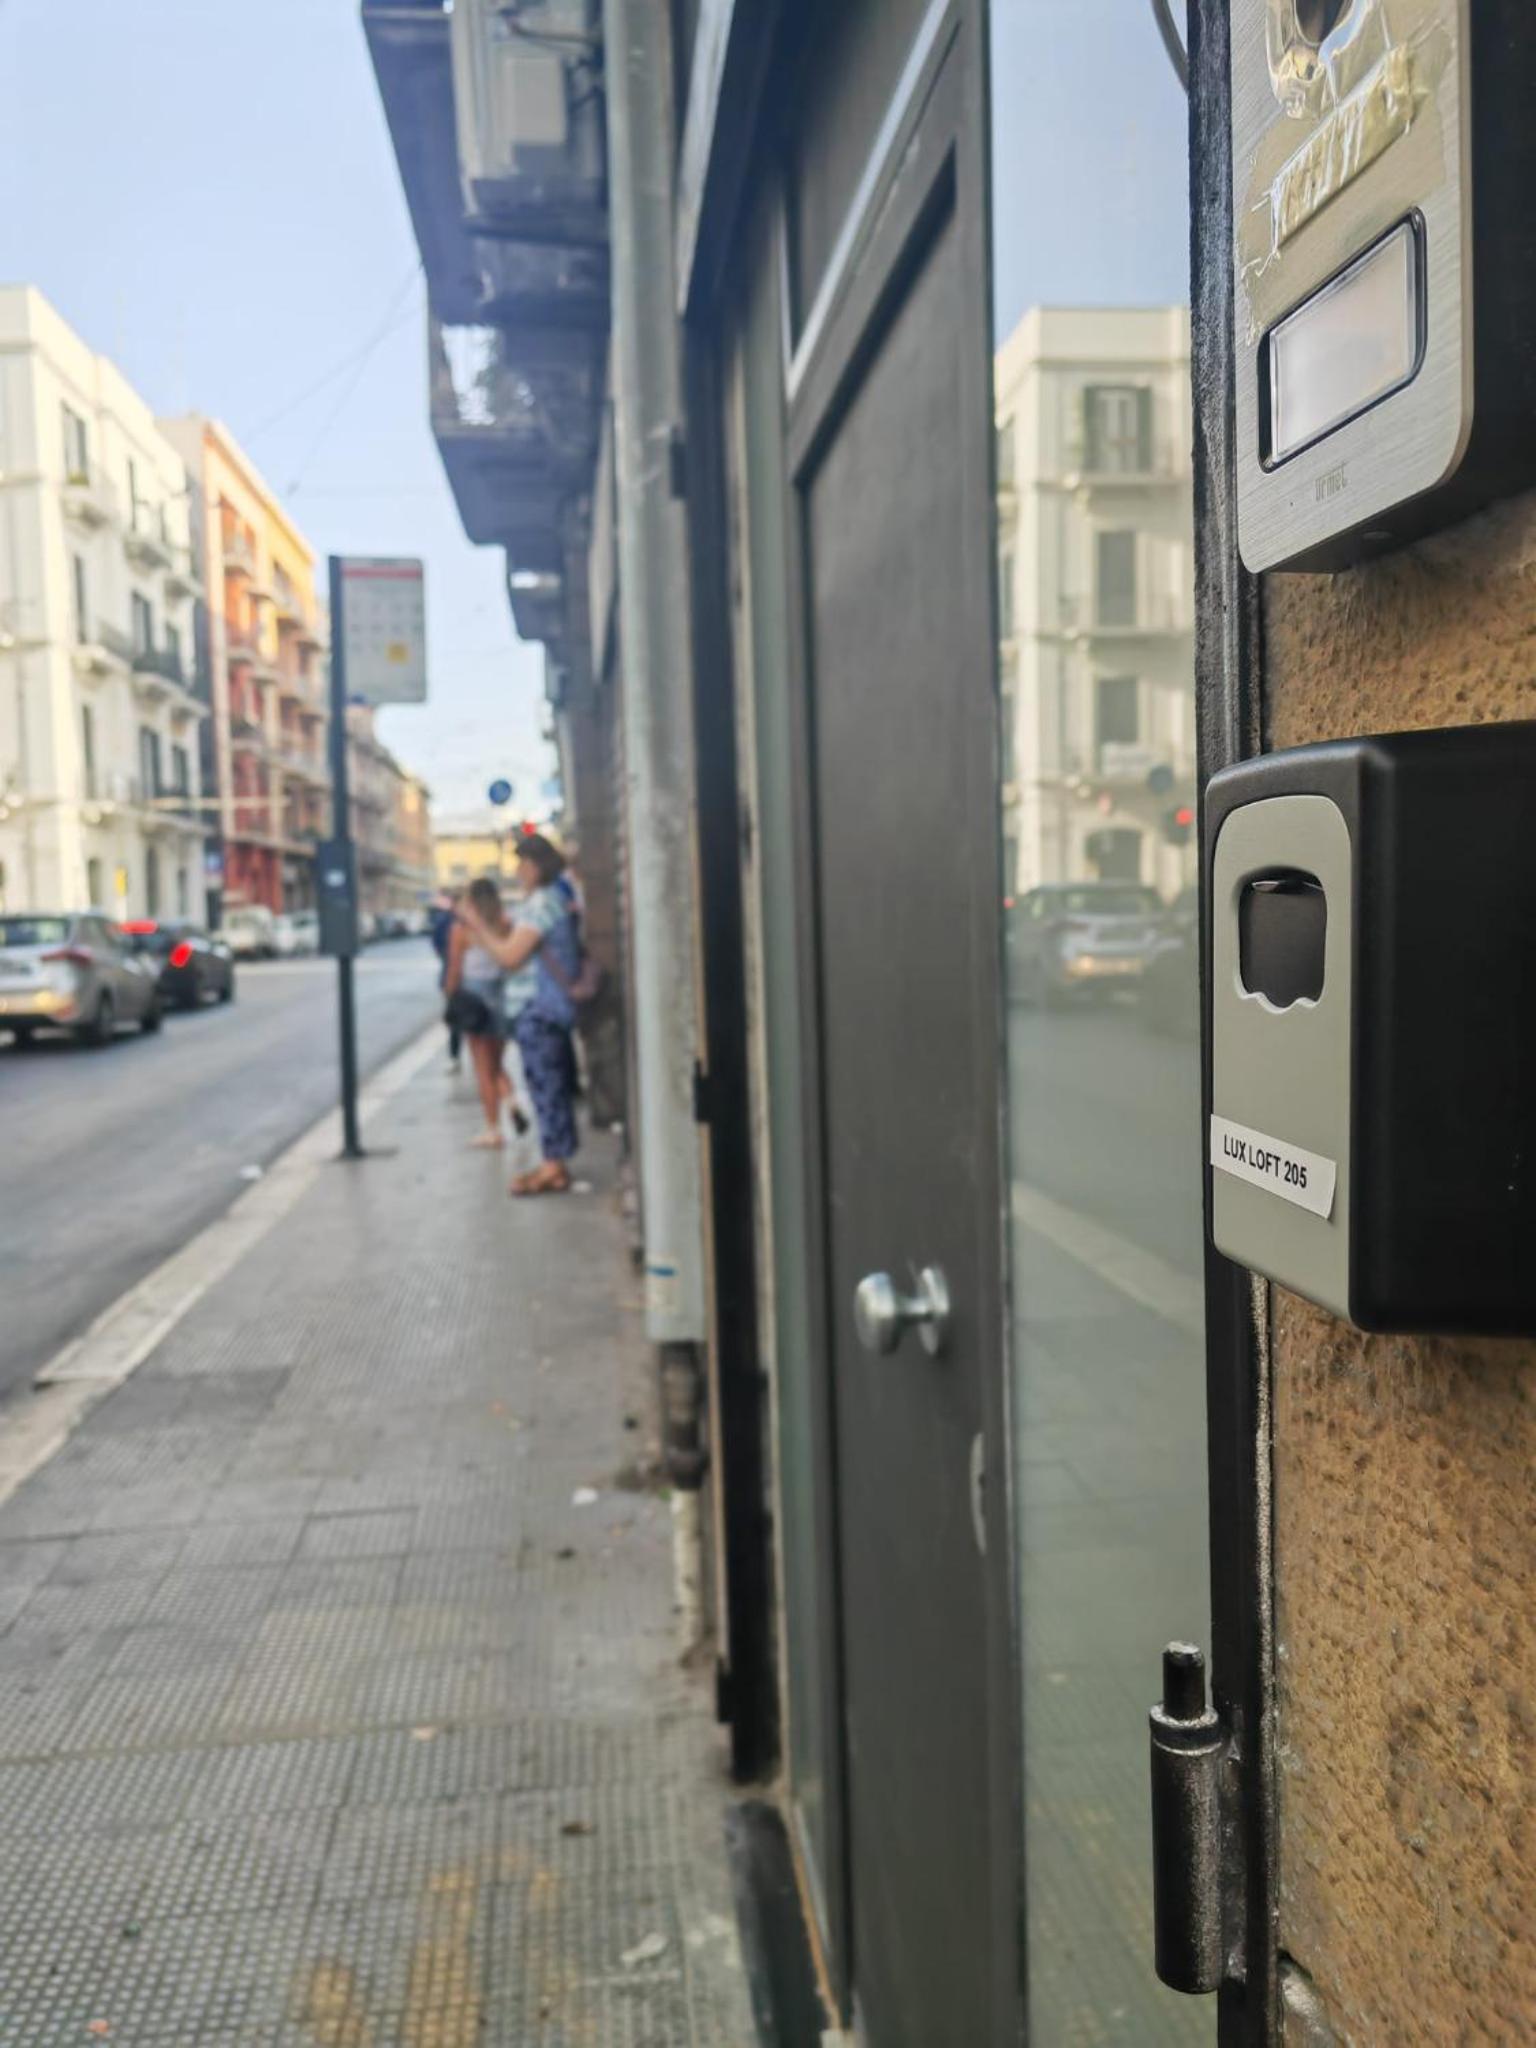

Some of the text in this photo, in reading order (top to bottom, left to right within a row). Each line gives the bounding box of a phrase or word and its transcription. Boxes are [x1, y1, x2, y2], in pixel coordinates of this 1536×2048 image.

[1224, 1134, 1307, 1188] LUX LOFT 205
